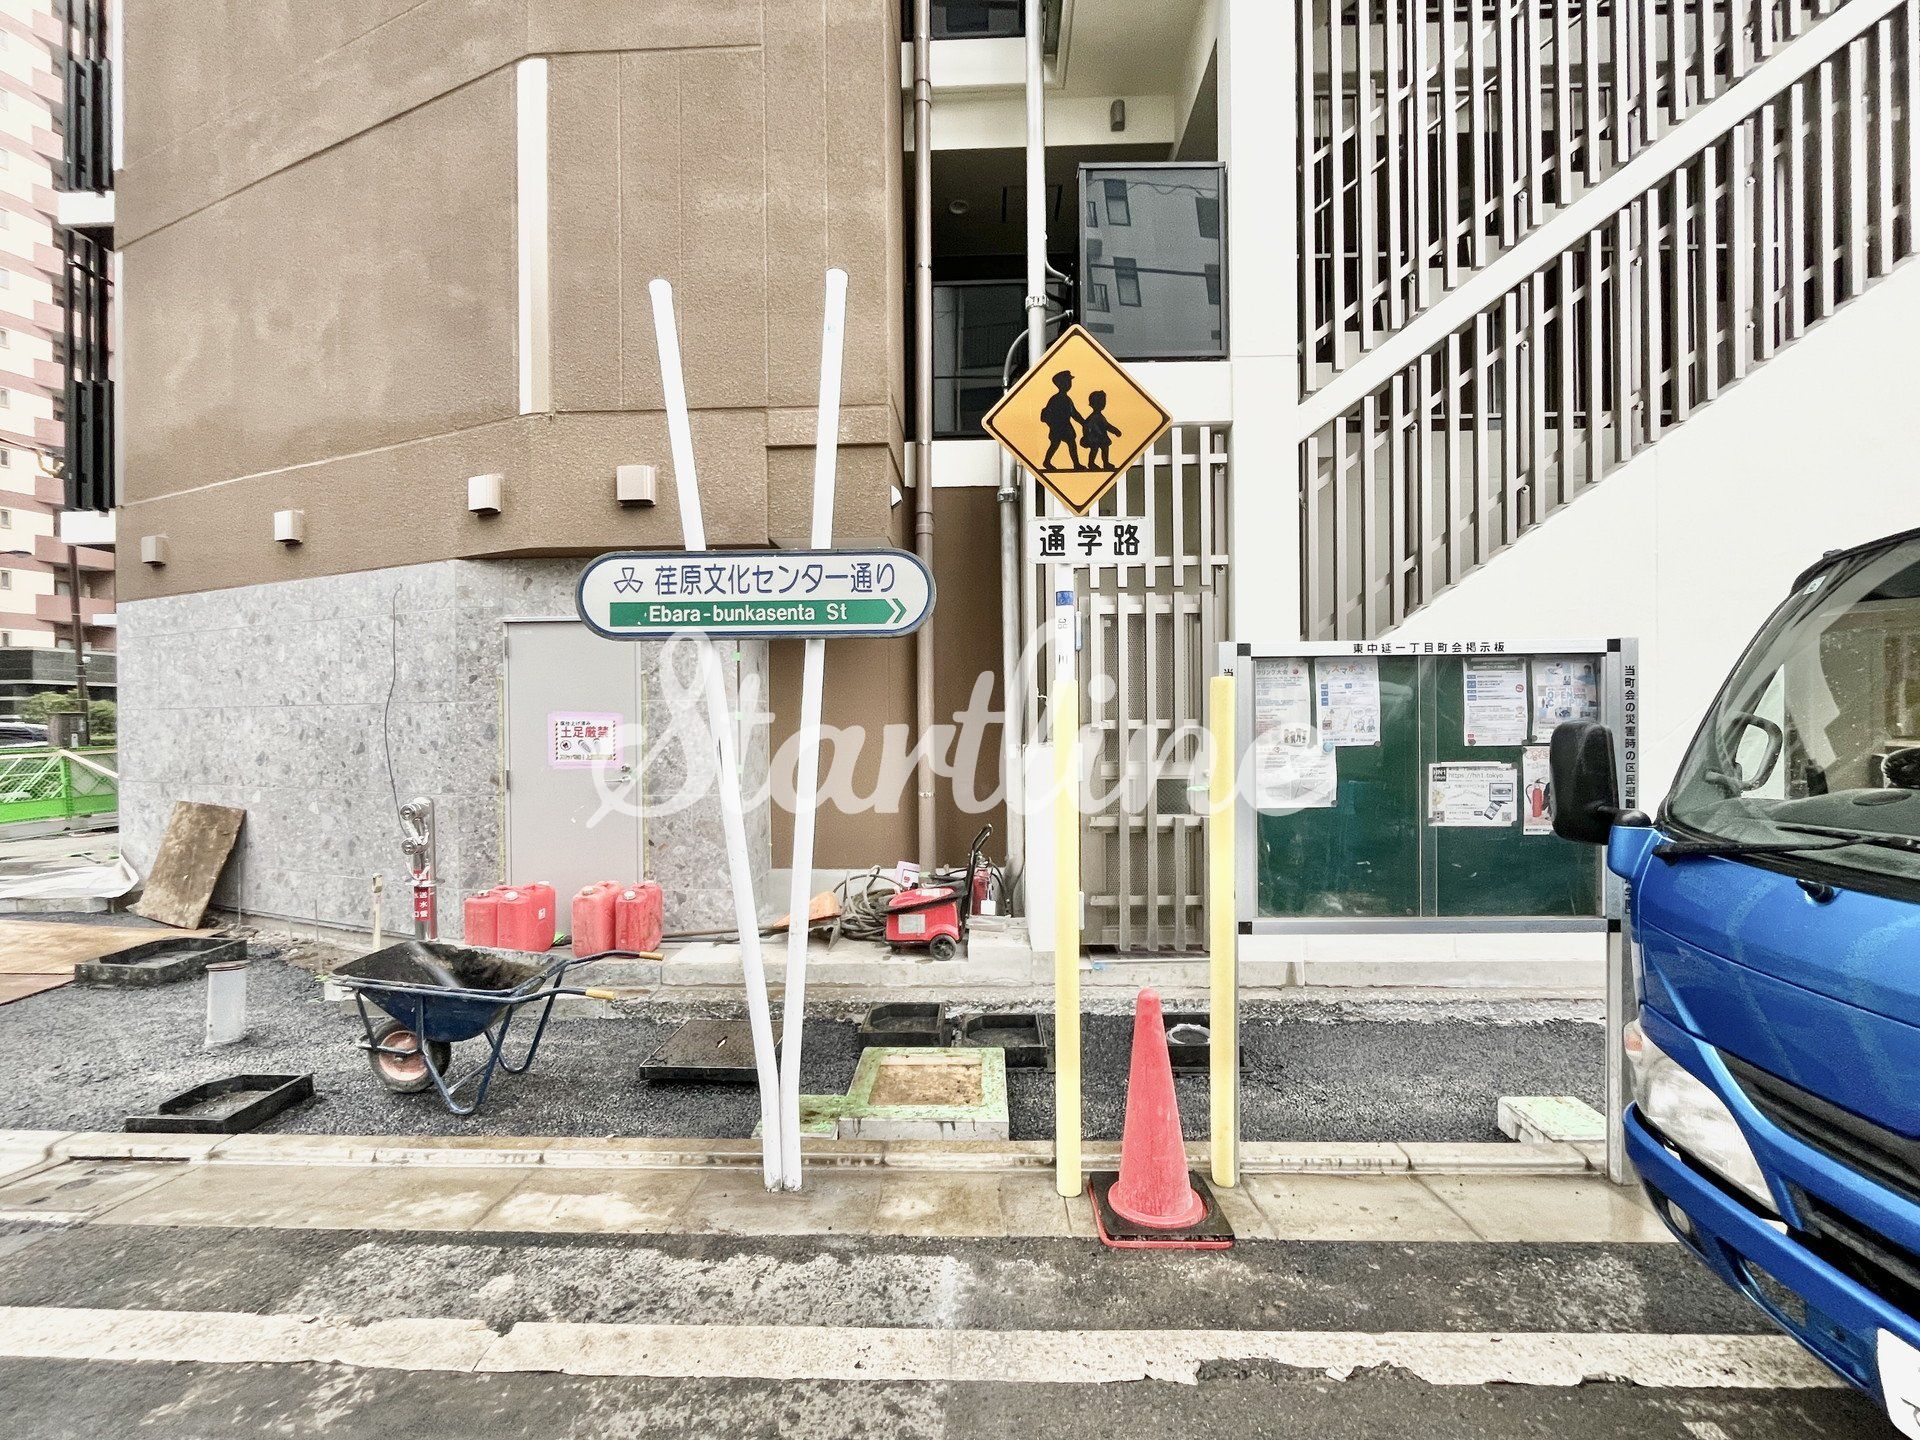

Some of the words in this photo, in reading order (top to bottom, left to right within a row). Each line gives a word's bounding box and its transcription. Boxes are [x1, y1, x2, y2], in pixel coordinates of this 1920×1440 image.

[1039, 524, 1140, 557] 通学路
[654, 563, 895, 595] 荏原文化センター通り
[648, 603, 816, 623] Ebara-bunkasenta
[826, 604, 847, 621] St
[1353, 641, 1505, 654] 東中延一丁目町会掲示板
[560, 725, 609, 739] 土足厳禁
